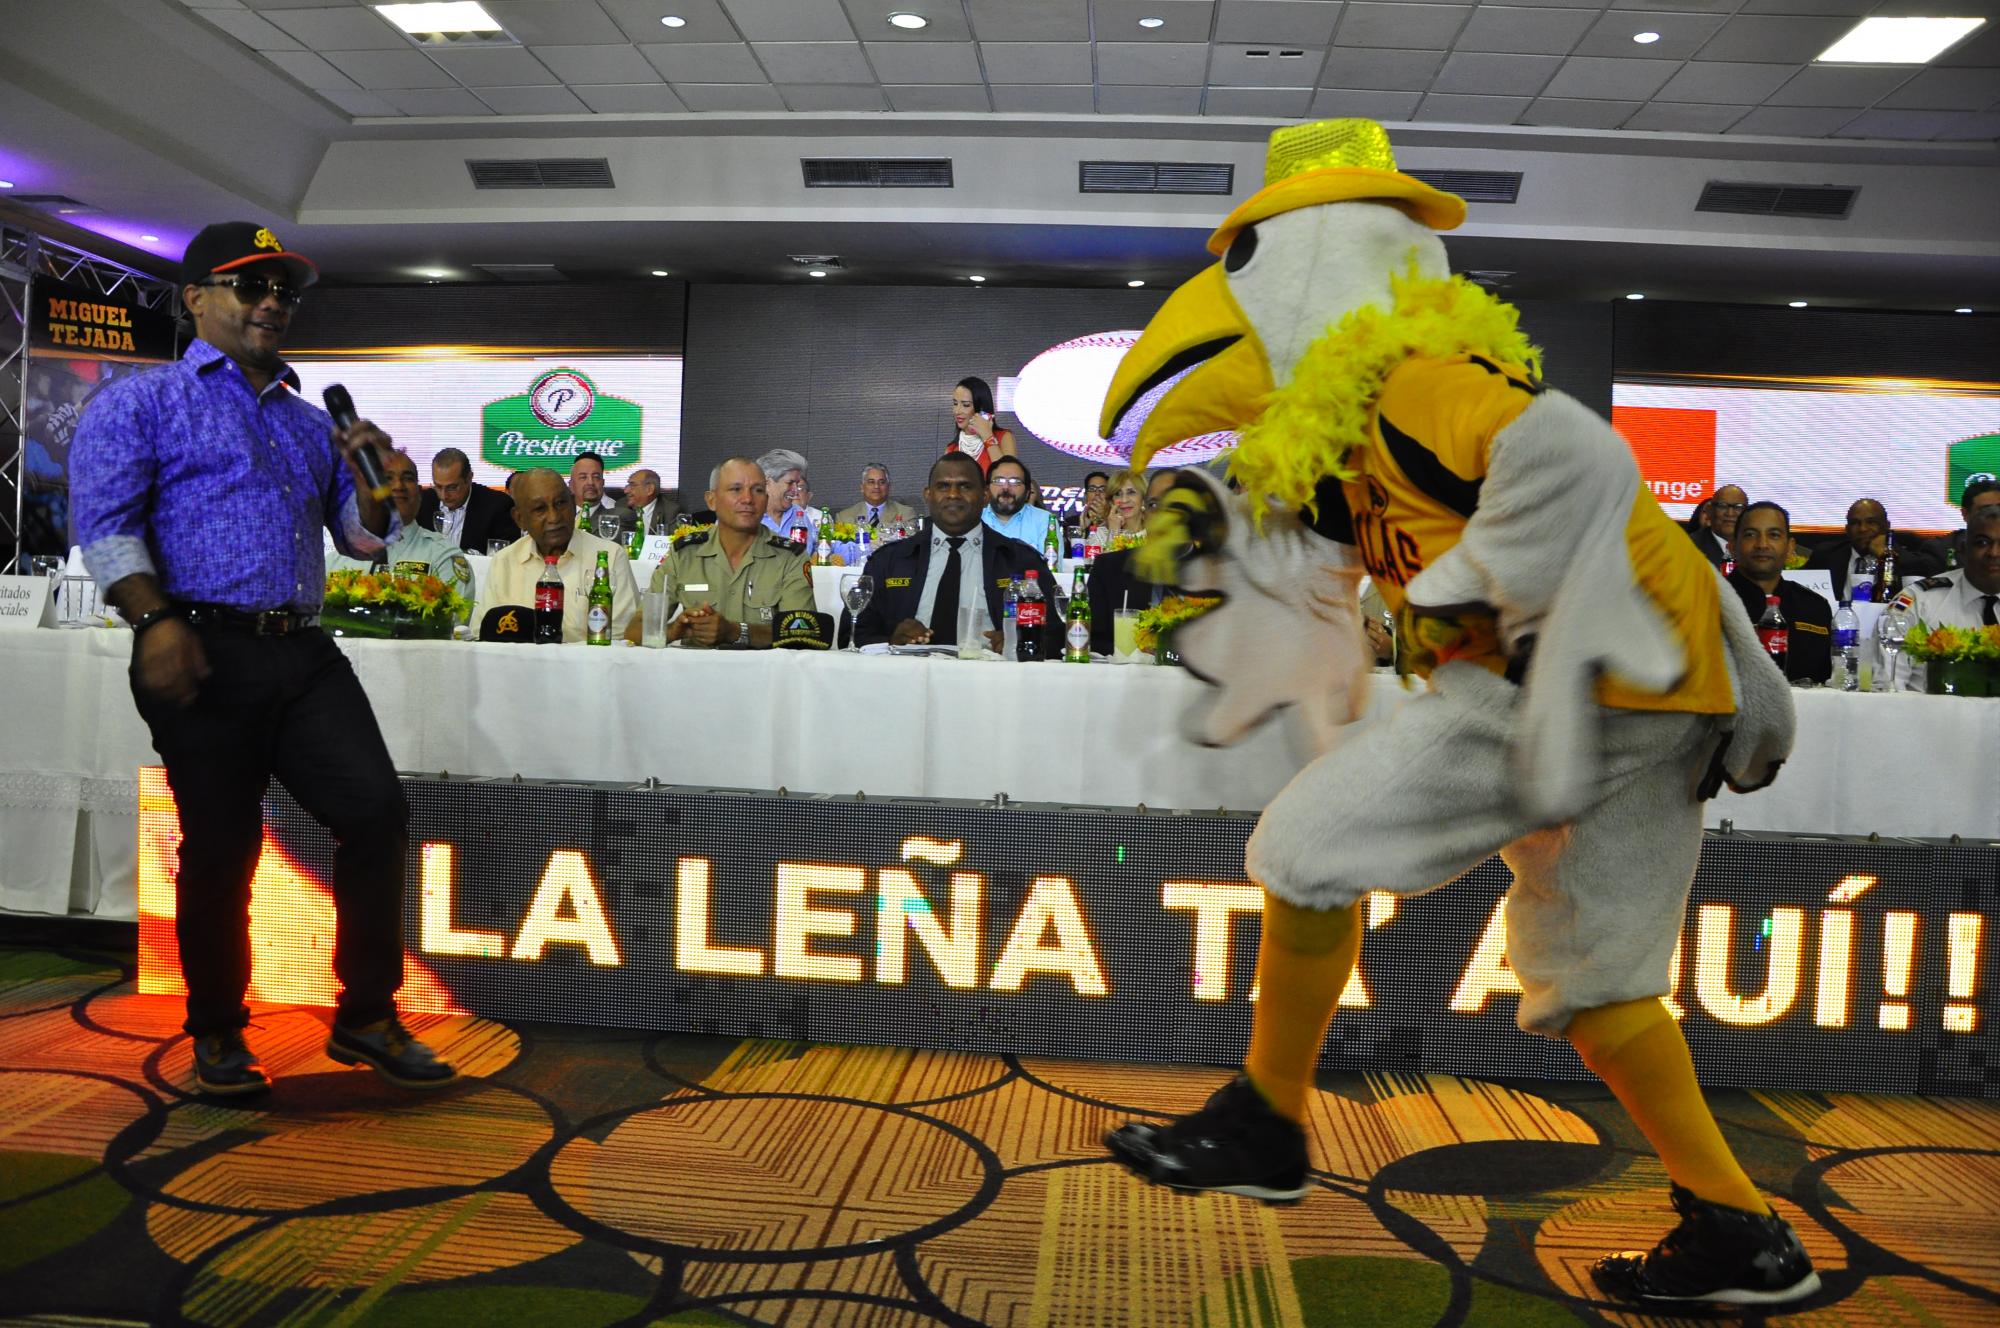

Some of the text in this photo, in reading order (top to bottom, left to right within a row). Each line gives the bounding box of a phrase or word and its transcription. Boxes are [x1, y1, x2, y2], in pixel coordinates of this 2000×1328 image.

[48, 298, 132, 328] MIGUEL
[48, 323, 136, 351] TEJADA
[496, 431, 625, 457] Presidente
[1644, 480, 1702, 501] nge
[0, 585, 31, 600] itados
[0, 603, 29, 617] ciales
[420, 842, 622, 966] LA
[676, 835, 1107, 995] LEÑA
